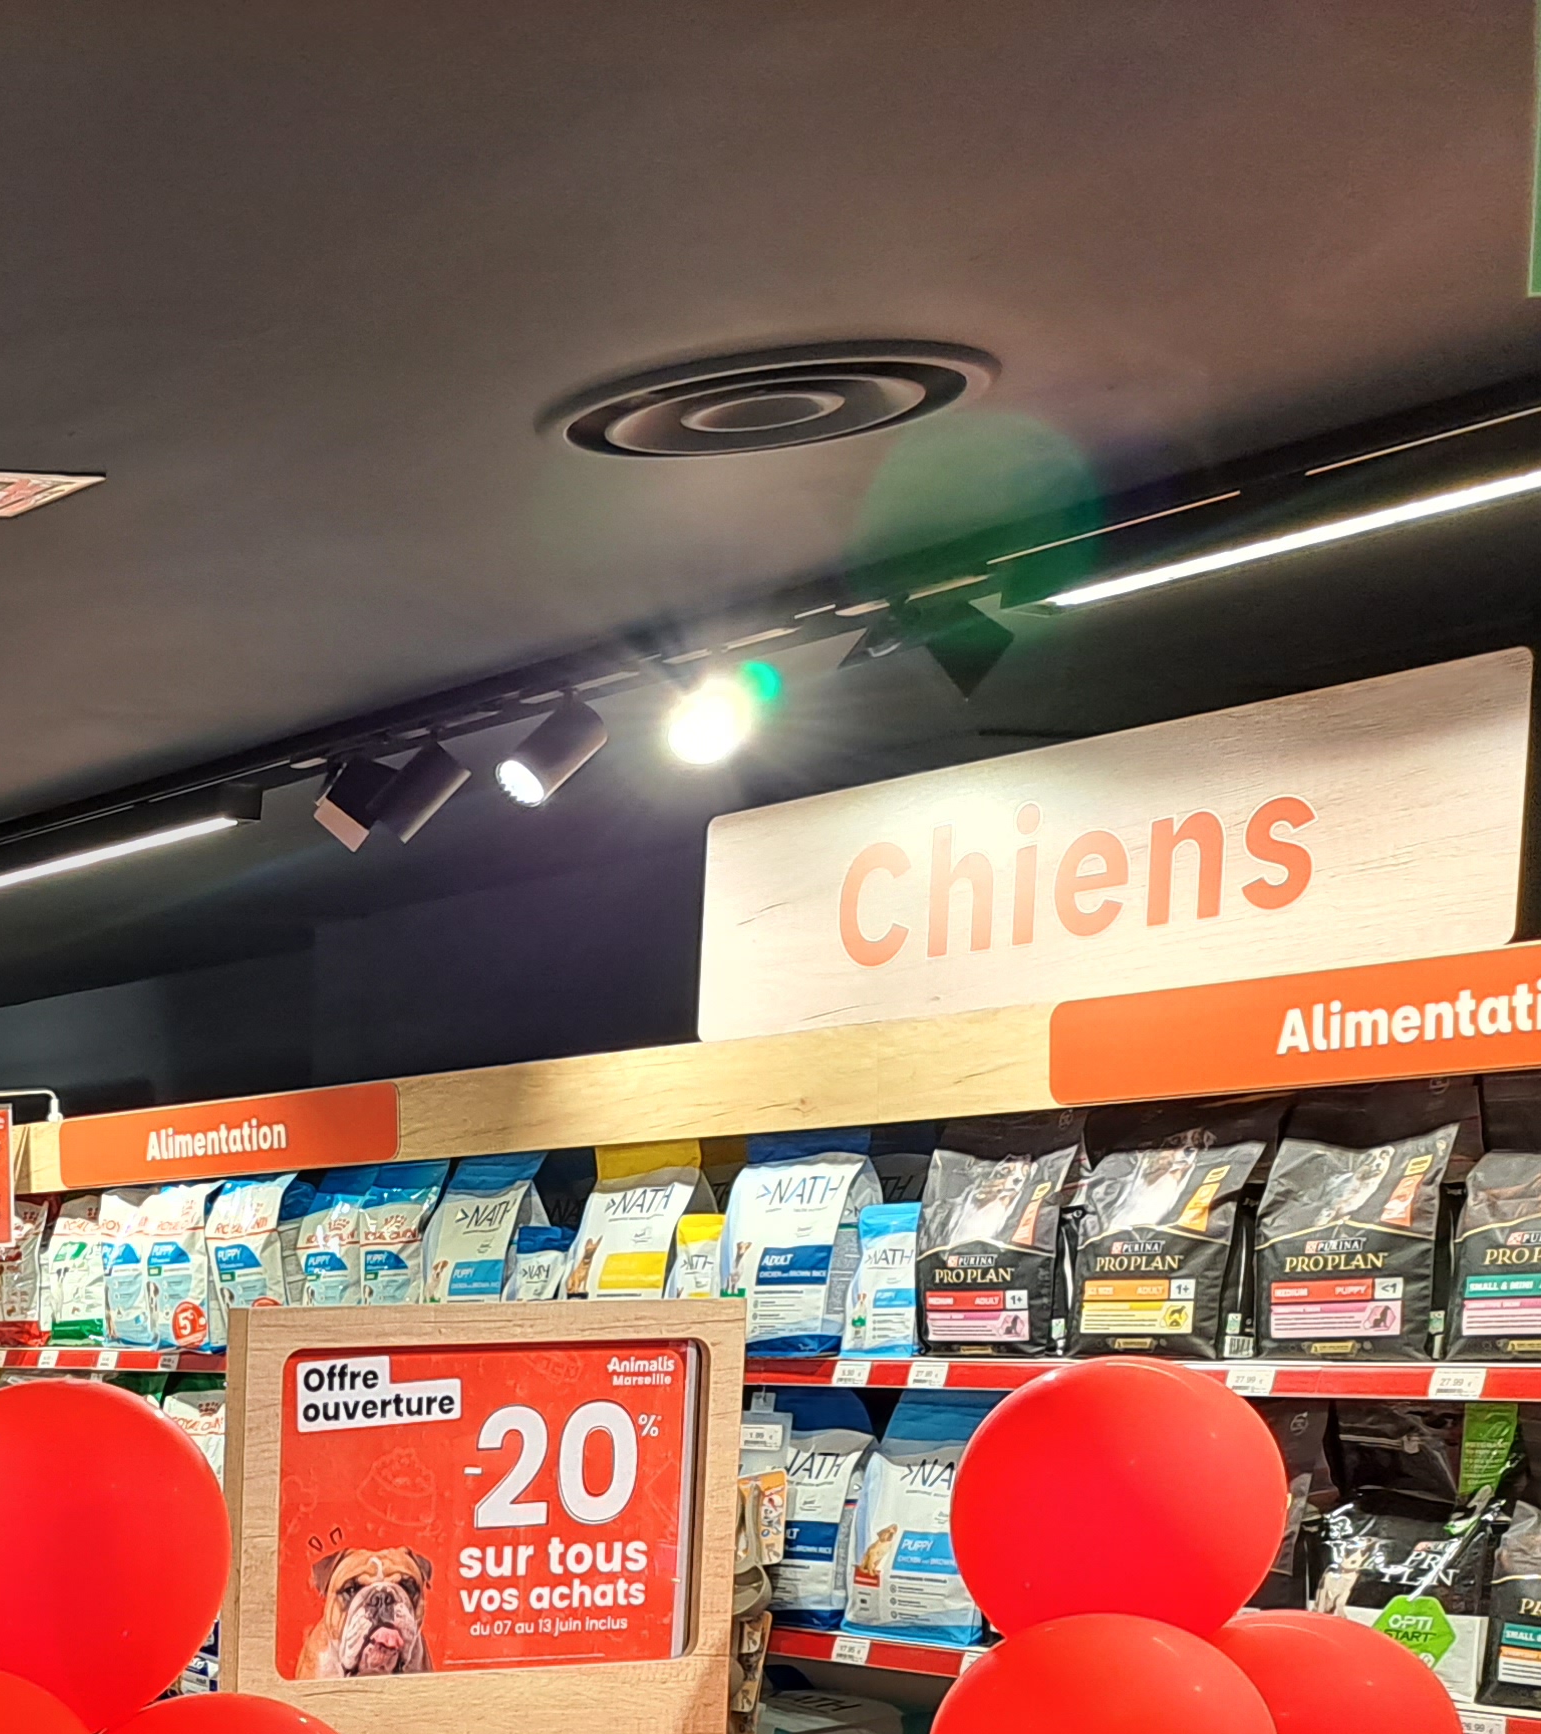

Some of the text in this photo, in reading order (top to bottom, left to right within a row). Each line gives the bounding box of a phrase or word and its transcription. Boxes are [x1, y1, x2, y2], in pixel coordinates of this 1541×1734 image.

[838, 794, 1318, 968] Chiens
[146, 1118, 287, 1161] Alimentation
[1122, 1241, 1162, 1253] PURINA
[1317, 1239, 1363, 1252] PURINA
[761, 1253, 793, 1268] ADULT
[958, 1255, 995, 1267] PURINA
[1136, 1285, 1163, 1295] ADULT
[1335, 1285, 1366, 1295] PUPPY
[607, 1356, 675, 1375] Animalis
[303, 1366, 379, 1393] Offre
[612, 1373, 672, 1386] Marseille
[303, 1391, 455, 1423] ouverture
[901, 1539, 934, 1551] PUPPY
[459, 1537, 648, 1578] sur tous
[460, 1579, 645, 1612] vos achats
[470, 1615, 627, 1637] du 07 au 13 juin inclus
[1388, 1615, 1434, 1631] OPTI
